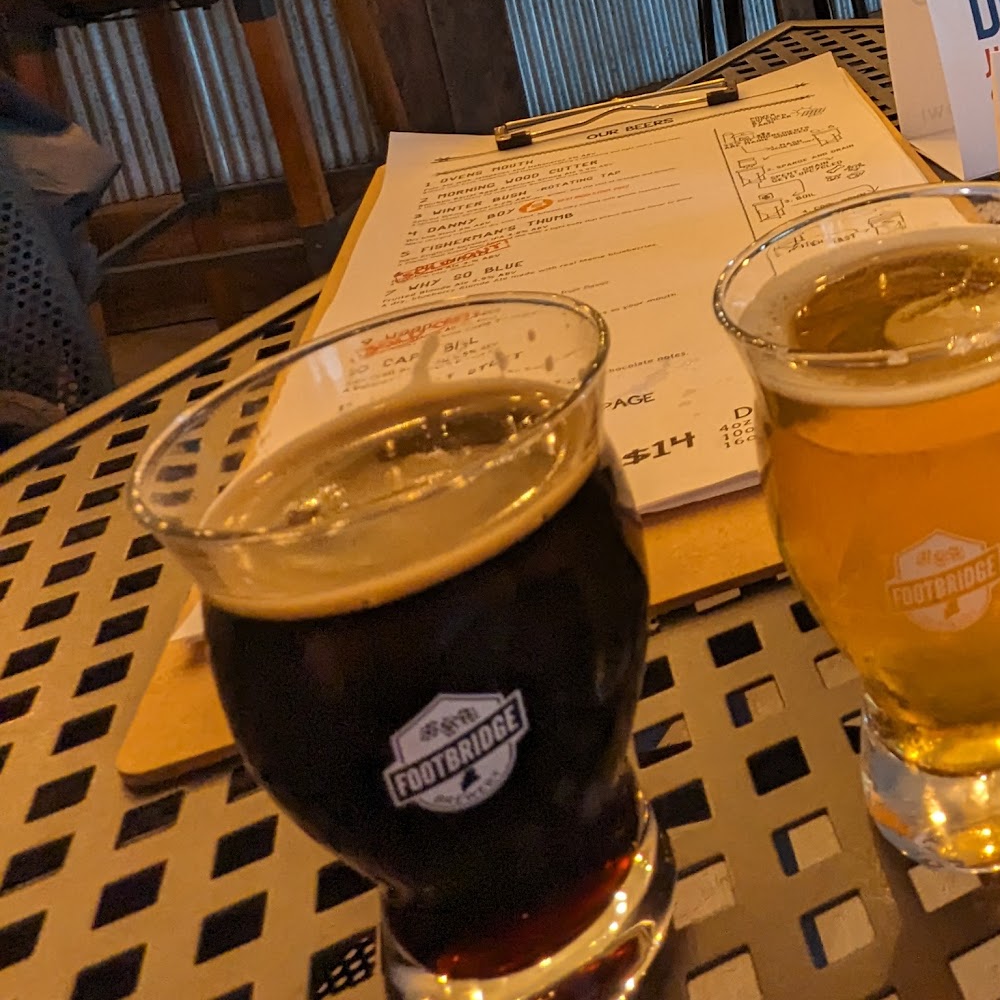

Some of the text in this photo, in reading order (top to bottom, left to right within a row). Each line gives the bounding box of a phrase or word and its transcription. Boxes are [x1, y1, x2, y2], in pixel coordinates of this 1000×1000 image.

[586, 118, 674, 140] OUR BEERS
[437, 182, 495, 199] MORNING
[505, 173, 540, 184] WOOD
[549, 159, 598, 174] CUTTER
[440, 170, 482, 183] OVENS
[491, 159, 534, 172] MOUTH
[432, 201, 482, 215] WINTER
[492, 190, 527, 202] BUSH
[600, 170, 621, 178] TAP
[421, 225, 516, 253] FISHERMAN'S
[527, 212, 574, 226] THUMB
[427, 218, 476, 234] DANNY
[487, 208, 516, 220] BOY
[408, 278, 442, 291] WHY
[453, 271, 473, 281] SO
[484, 260, 524, 274] BLUE
[622, 431, 695, 466] $14
[893, 554, 996, 606] FOOTBRIDGE
[394, 704, 520, 797] FOOTBRIDGE
